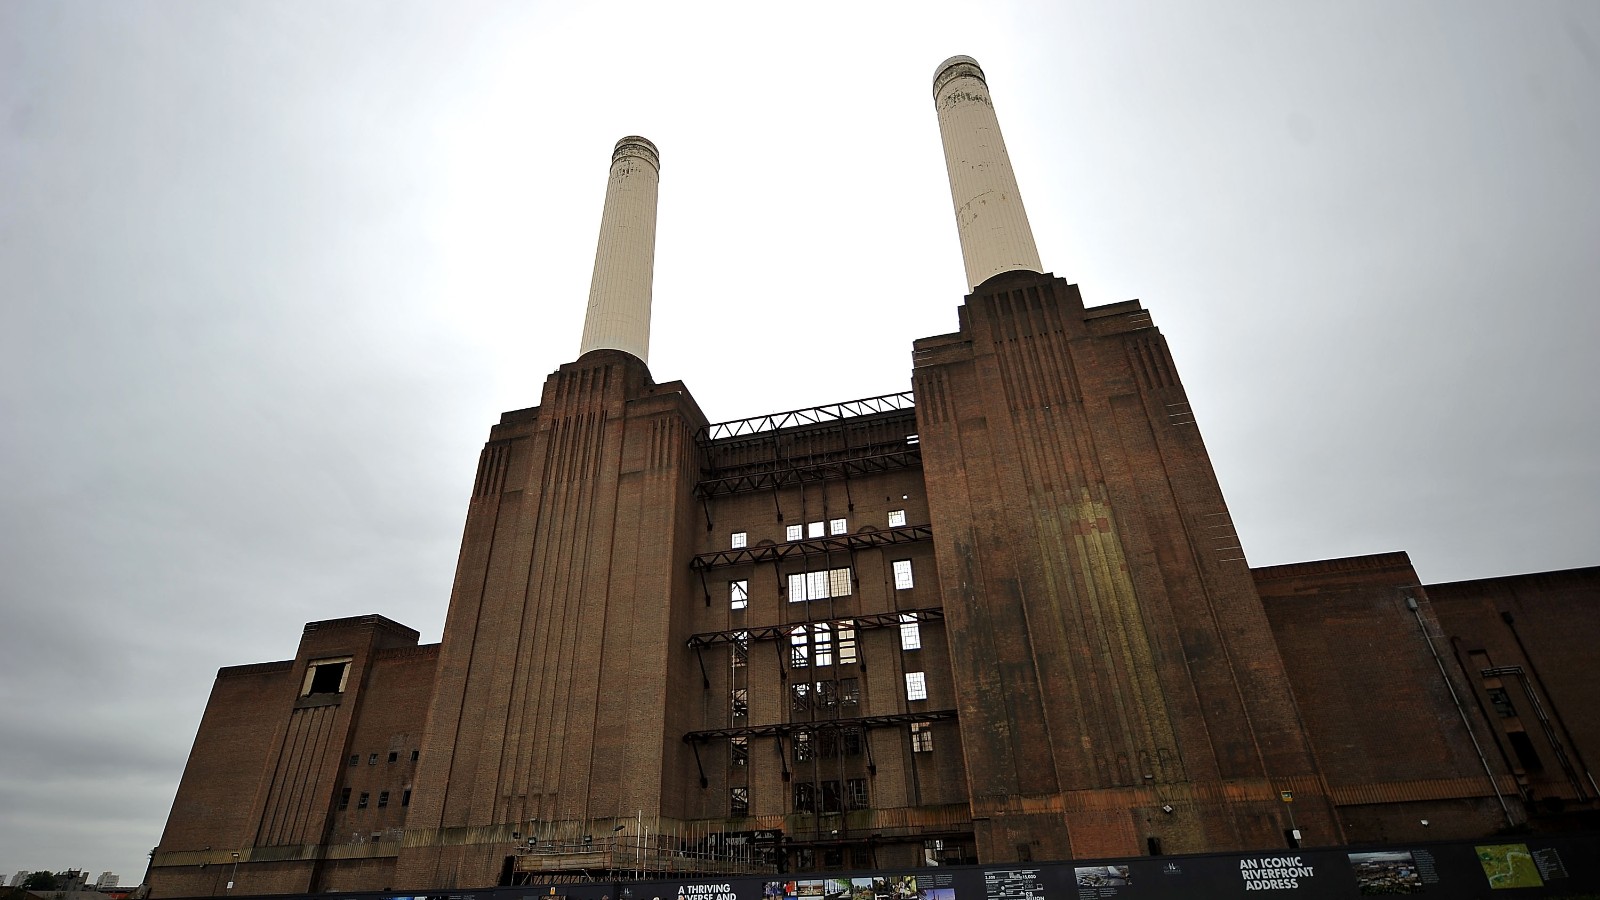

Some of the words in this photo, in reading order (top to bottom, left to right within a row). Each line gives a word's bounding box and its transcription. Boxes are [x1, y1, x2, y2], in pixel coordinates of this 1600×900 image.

[1240, 859, 1258, 869] AN
[1260, 856, 1303, 868] ICONIC
[1241, 866, 1314, 880] RIVERFRONT
[678, 885, 685, 894] A
[687, 884, 731, 894] THRIVING
[1246, 878, 1299, 890] ADDRESS
